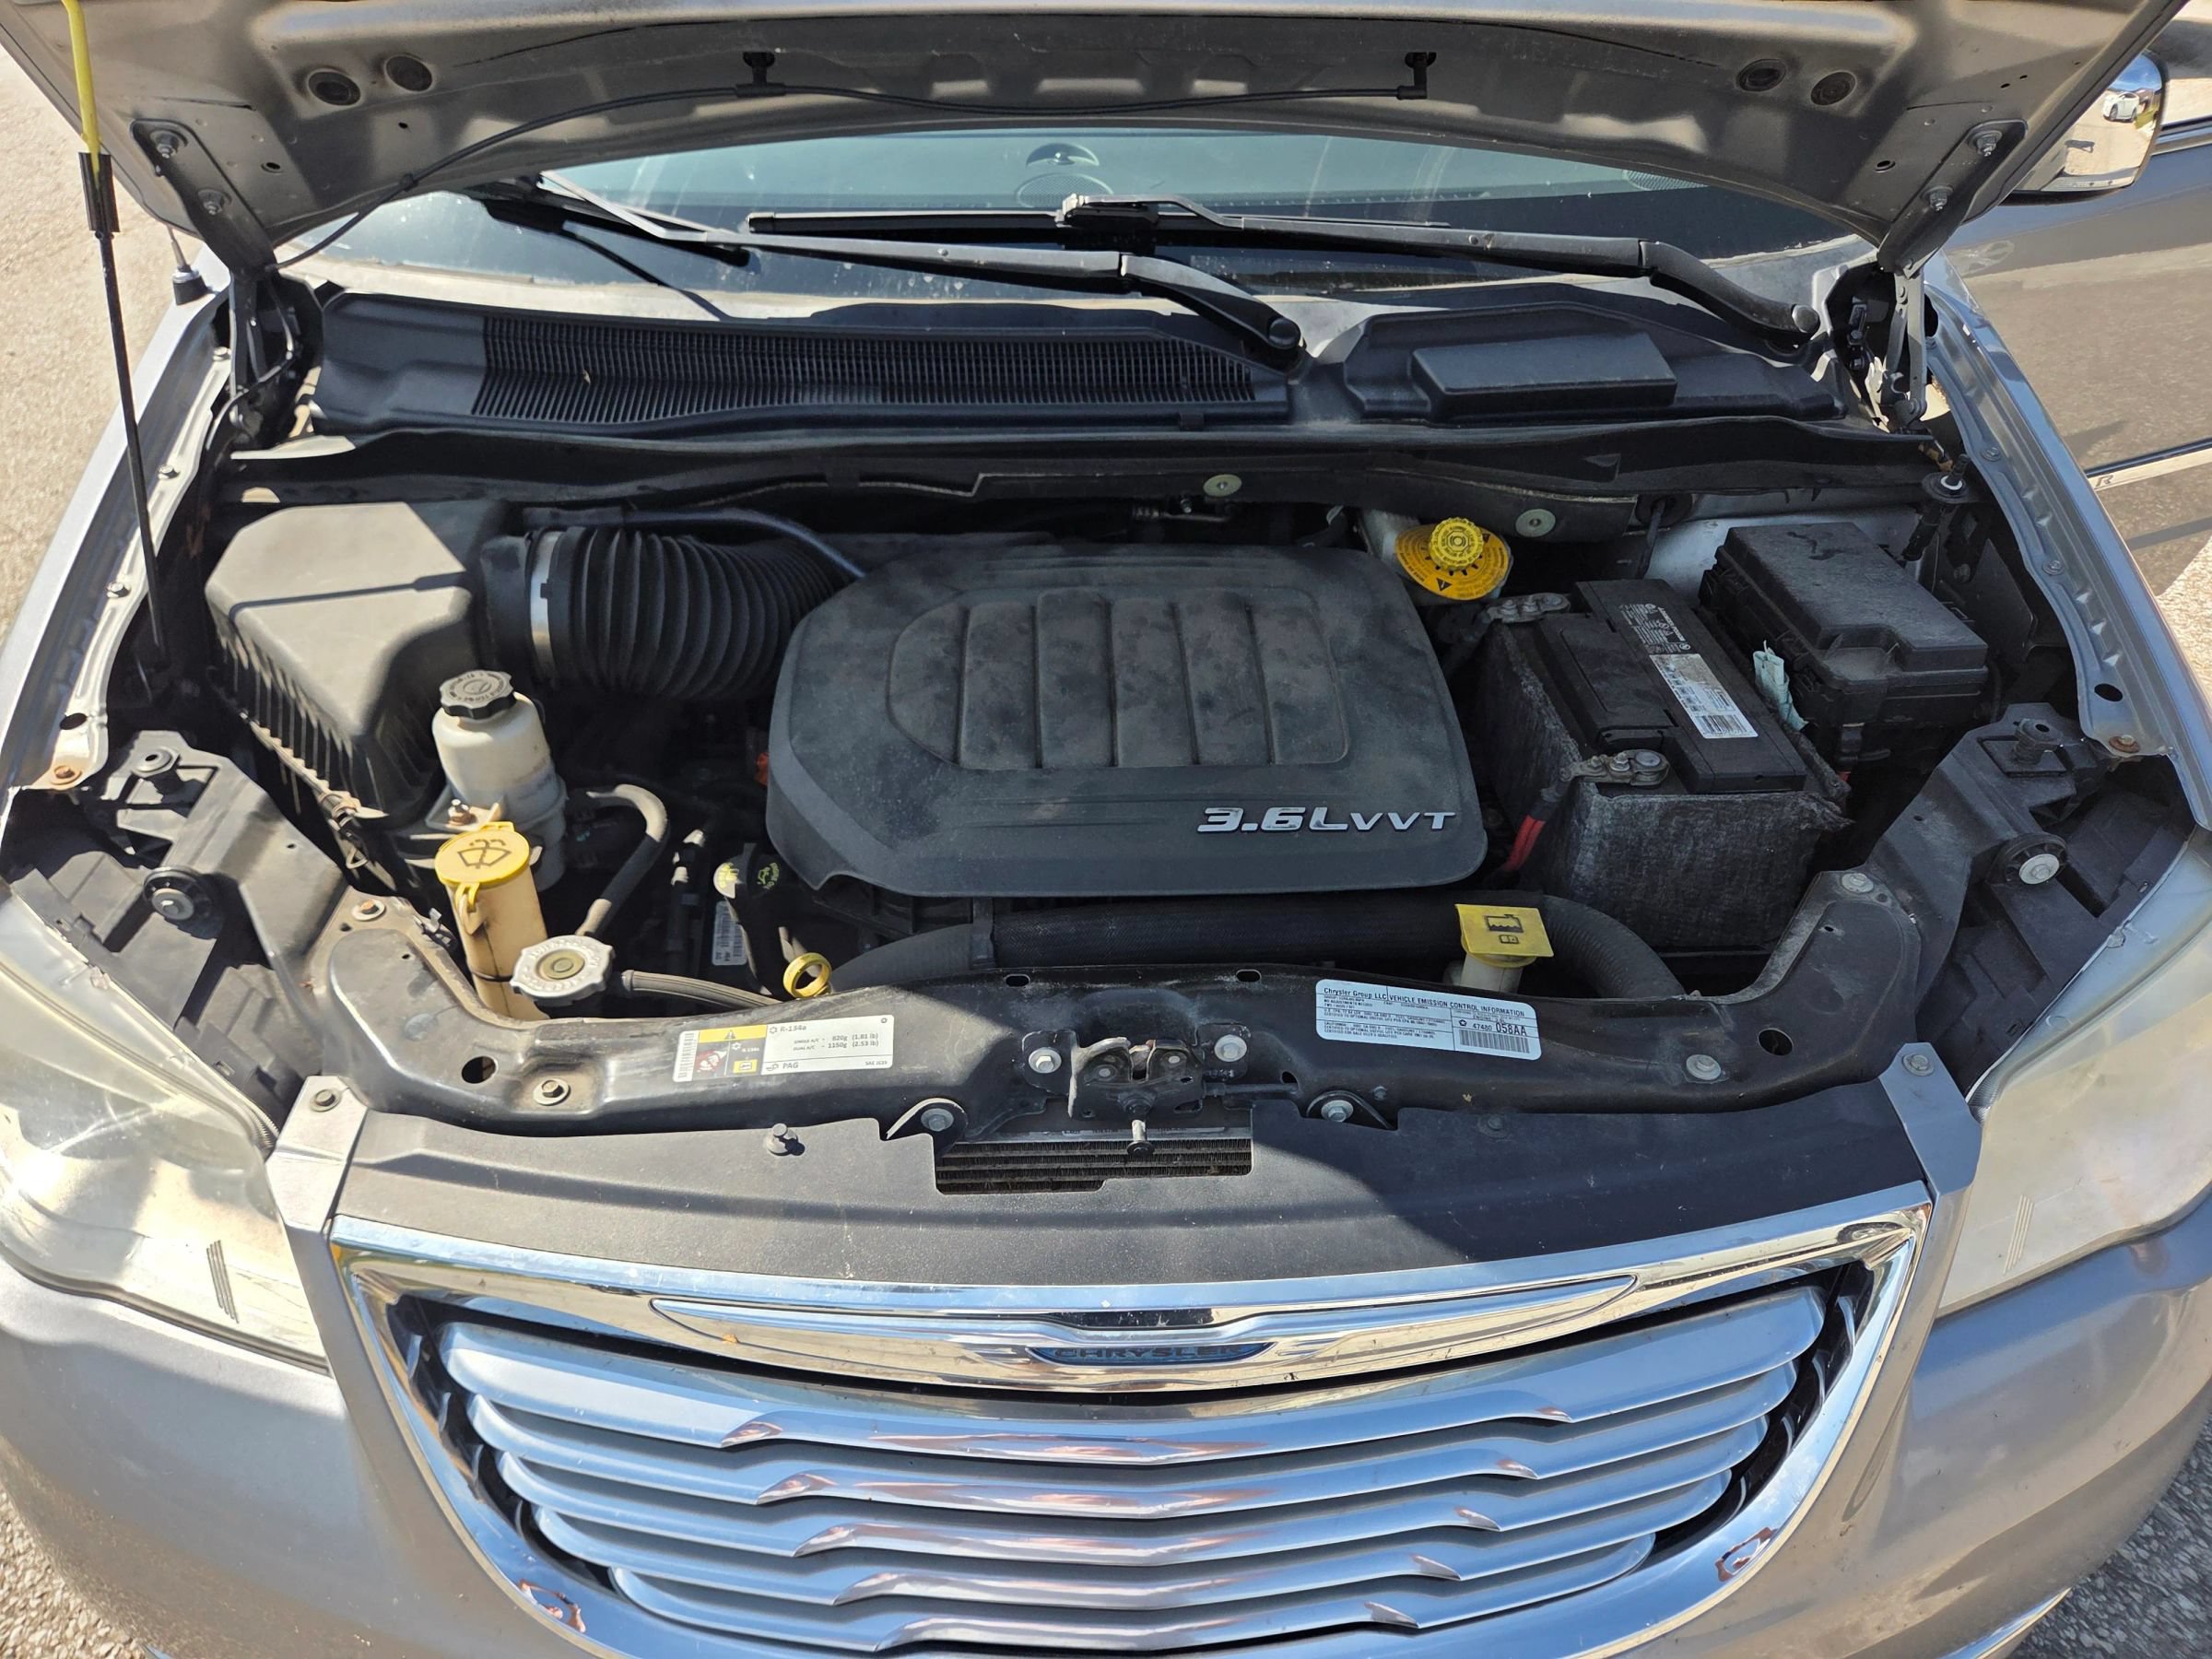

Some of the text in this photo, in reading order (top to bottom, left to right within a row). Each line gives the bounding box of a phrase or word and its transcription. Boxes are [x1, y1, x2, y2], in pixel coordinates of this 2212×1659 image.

[1324, 986, 1350, 997] Chrysler
[1352, 990, 1371, 999] Group
[1389, 994, 1414, 1003] VEHICLE
[1418, 997, 1447, 1006] EMISSION
[1450, 1001, 1478, 1011] CONTROL
[1480, 1005, 1524, 1017] INFORMATION
[779, 1024, 806, 1033] R-134a
[1495, 1021, 1527, 1035] 058AA
[852, 1032, 868, 1041] (1.81
[868, 1031, 878, 1040] lb)
[828, 1041, 847, 1050] 1150g
[852, 1040, 868, 1048] (2.53
[869, 1039, 878, 1047] lb)
[782, 1062, 799, 1070] PAG
